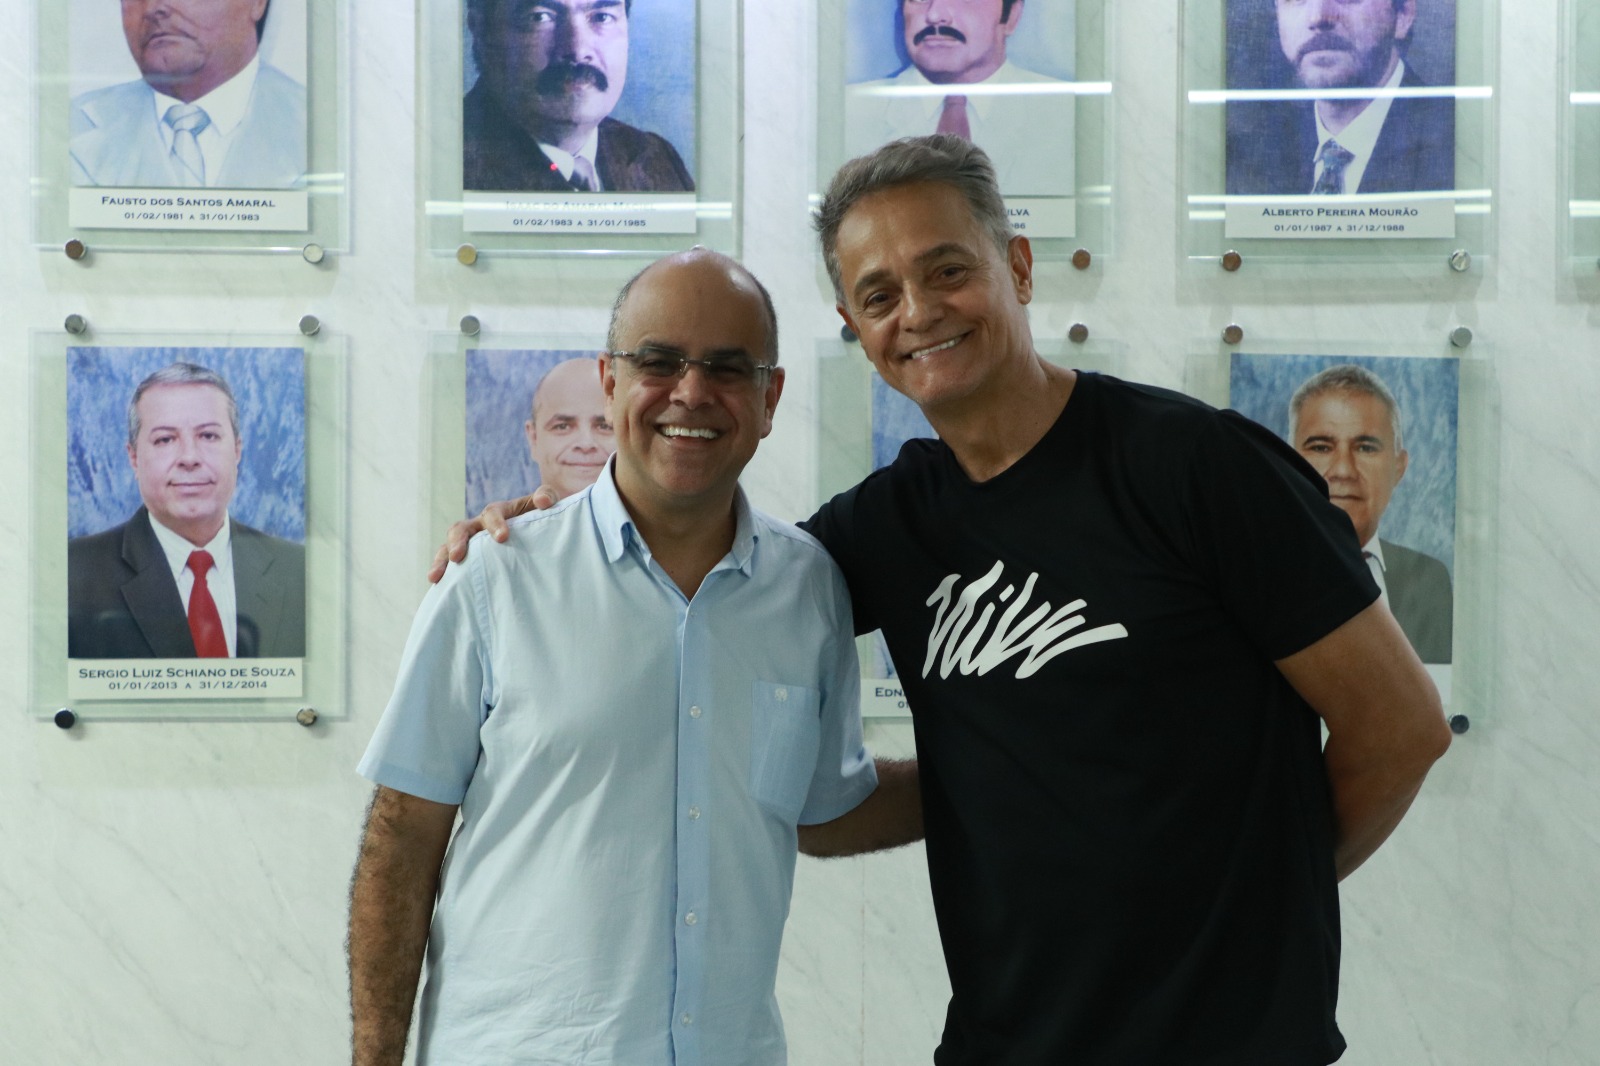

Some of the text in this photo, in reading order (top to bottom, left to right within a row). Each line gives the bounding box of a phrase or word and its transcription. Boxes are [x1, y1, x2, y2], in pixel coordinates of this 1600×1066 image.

[101, 196, 276, 208] FAUSTO DOS SANTOS AMARAL
[124, 212, 184, 220] 01/02/1981
[199, 213, 260, 221] 31/01/1983
[1007, 208, 1030, 216] ILVA
[1262, 207, 1418, 217] ALBERTO PEREIRA MOURÃO
[513, 218, 573, 226] 01/02/1983
[587, 219, 646, 227] 31/01/1985
[1274, 224, 1332, 232] 01/01/1987
[1347, 224, 1405, 232] 31/12/1988
[79, 667, 296, 679] SERGIO LUIZ SCHIANO DE SOUZA
[108, 681, 178, 690] 01/01/2013
[199, 680, 268, 689] 31/12/2014
[875, 687, 905, 697] EDN
